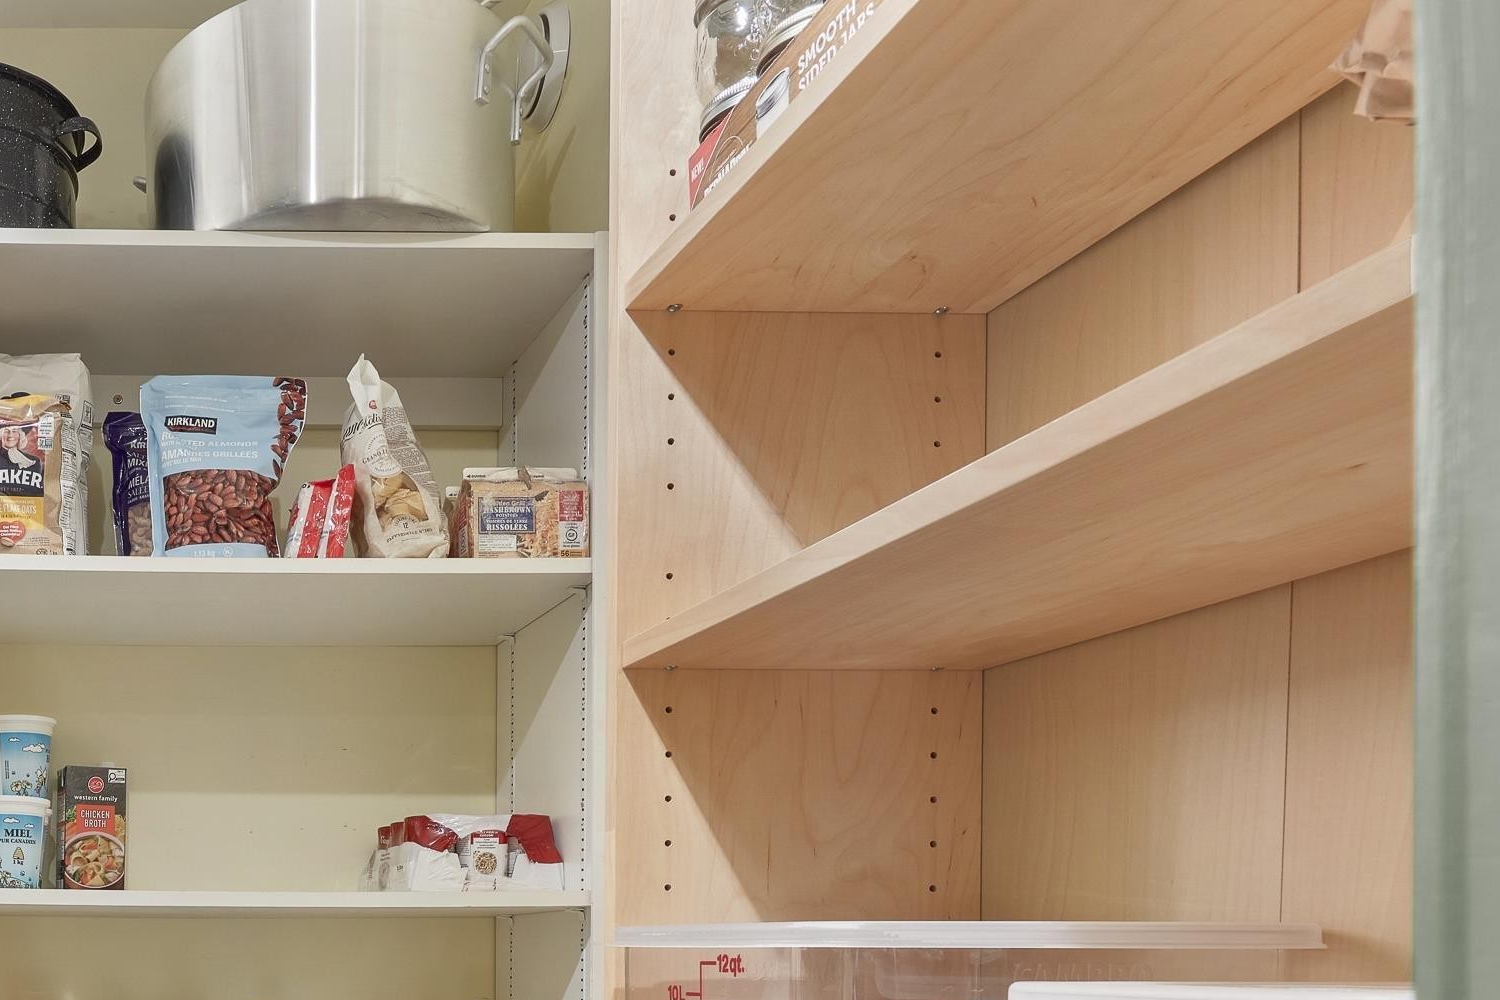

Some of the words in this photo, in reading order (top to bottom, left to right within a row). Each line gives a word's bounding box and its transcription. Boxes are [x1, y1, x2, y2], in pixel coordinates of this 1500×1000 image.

[797, 1, 858, 74] SMOOTH
[167, 417, 215, 428] KIRKLAND
[128, 473, 149, 490] MÉLA
[486, 522, 528, 531] RISSOLÉES
[73, 794, 98, 802] western
[98, 793, 118, 803] family
[80, 809, 110, 819] CHICKEN
[84, 819, 107, 828] BROTH
[4, 828, 32, 839] MIEL
